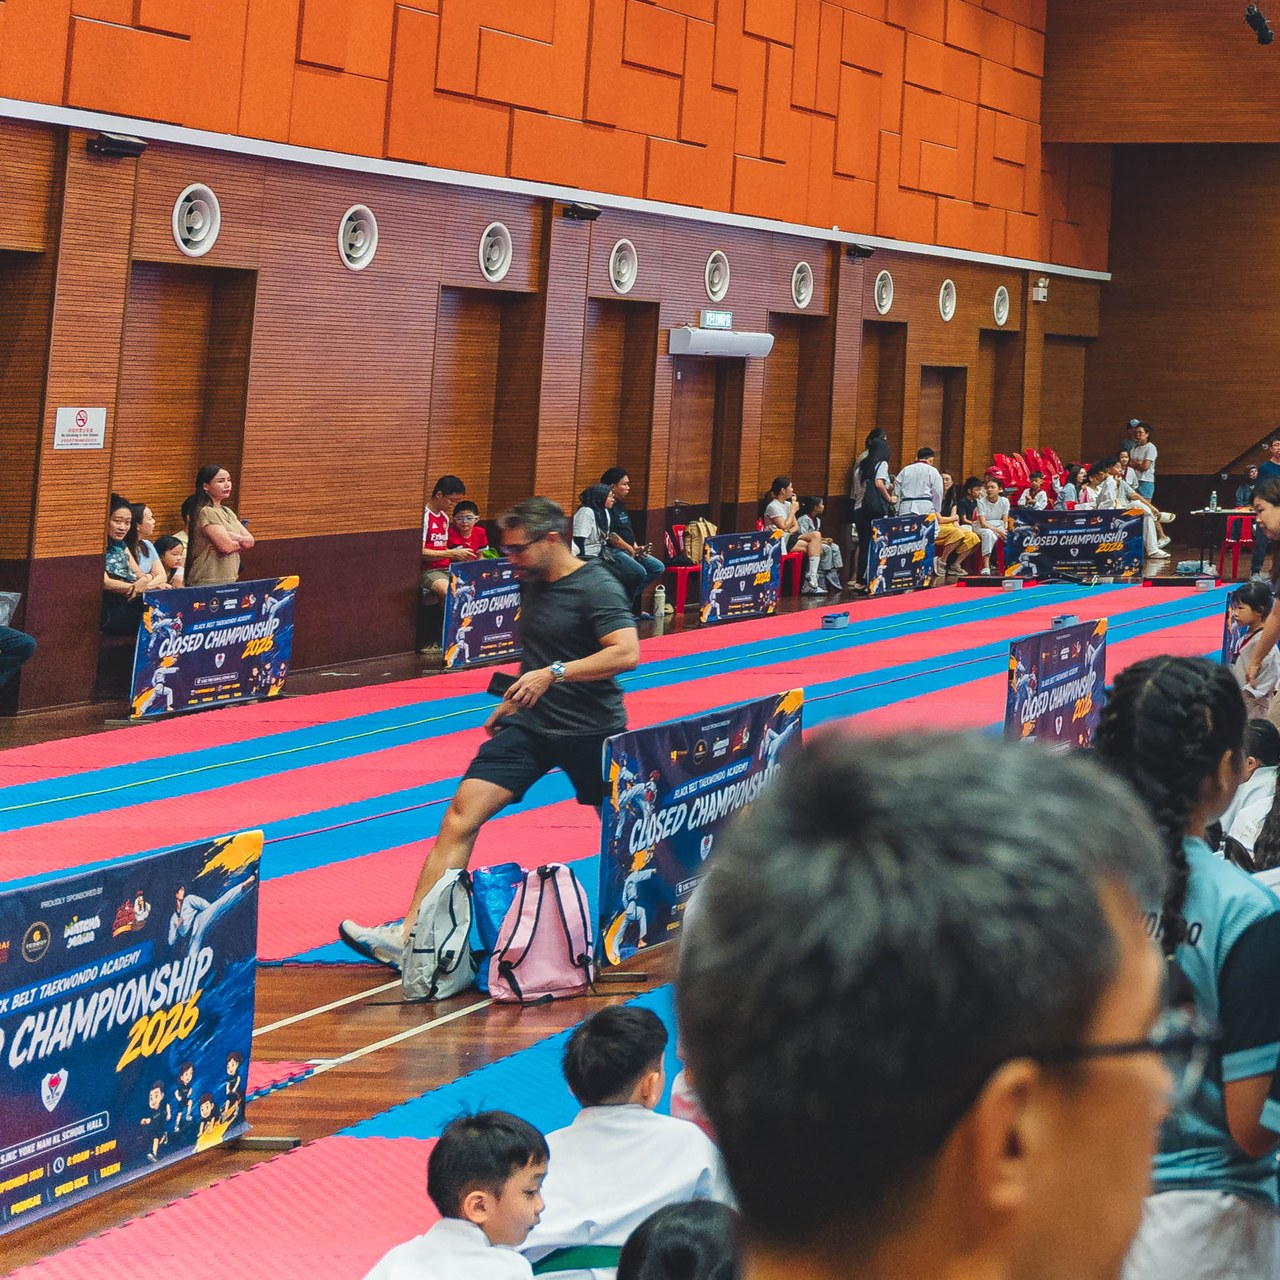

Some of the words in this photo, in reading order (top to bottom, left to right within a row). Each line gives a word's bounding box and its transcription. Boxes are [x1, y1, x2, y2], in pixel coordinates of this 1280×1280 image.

[1023, 535, 1058, 547] CLOSED
[1060, 531, 1128, 546] CHAMPIONSHIP
[1095, 541, 1124, 554] 2026
[713, 565, 735, 582] CLOSED
[460, 598, 489, 619] CLOSED
[158, 632, 204, 658] CLOSED
[204, 618, 280, 650] CHAMPIONSHIP
[241, 634, 275, 659] 2026
[1021, 690, 1049, 724] CLOSED
[1049, 671, 1096, 712] CHAMPIONSHIP
[1072, 691, 1092, 724] 2026
[673, 787, 688, 800] BLACK
[688, 783, 698, 794] BELT
[699, 771, 726, 791] TAEKWONDO
[727, 761, 749, 778] ACADEMY
[629, 802, 687, 856] CLOSED
[11, 988, 38, 1011] BELT
[40, 966, 98, 1000] TAEKWONDO
[100, 949, 142, 977] ACADEMY
[8, 945, 214, 1070] CHAMPIONSHIP
[115, 988, 202, 1072] 2026
[86, 1118, 104, 1132] HALL
